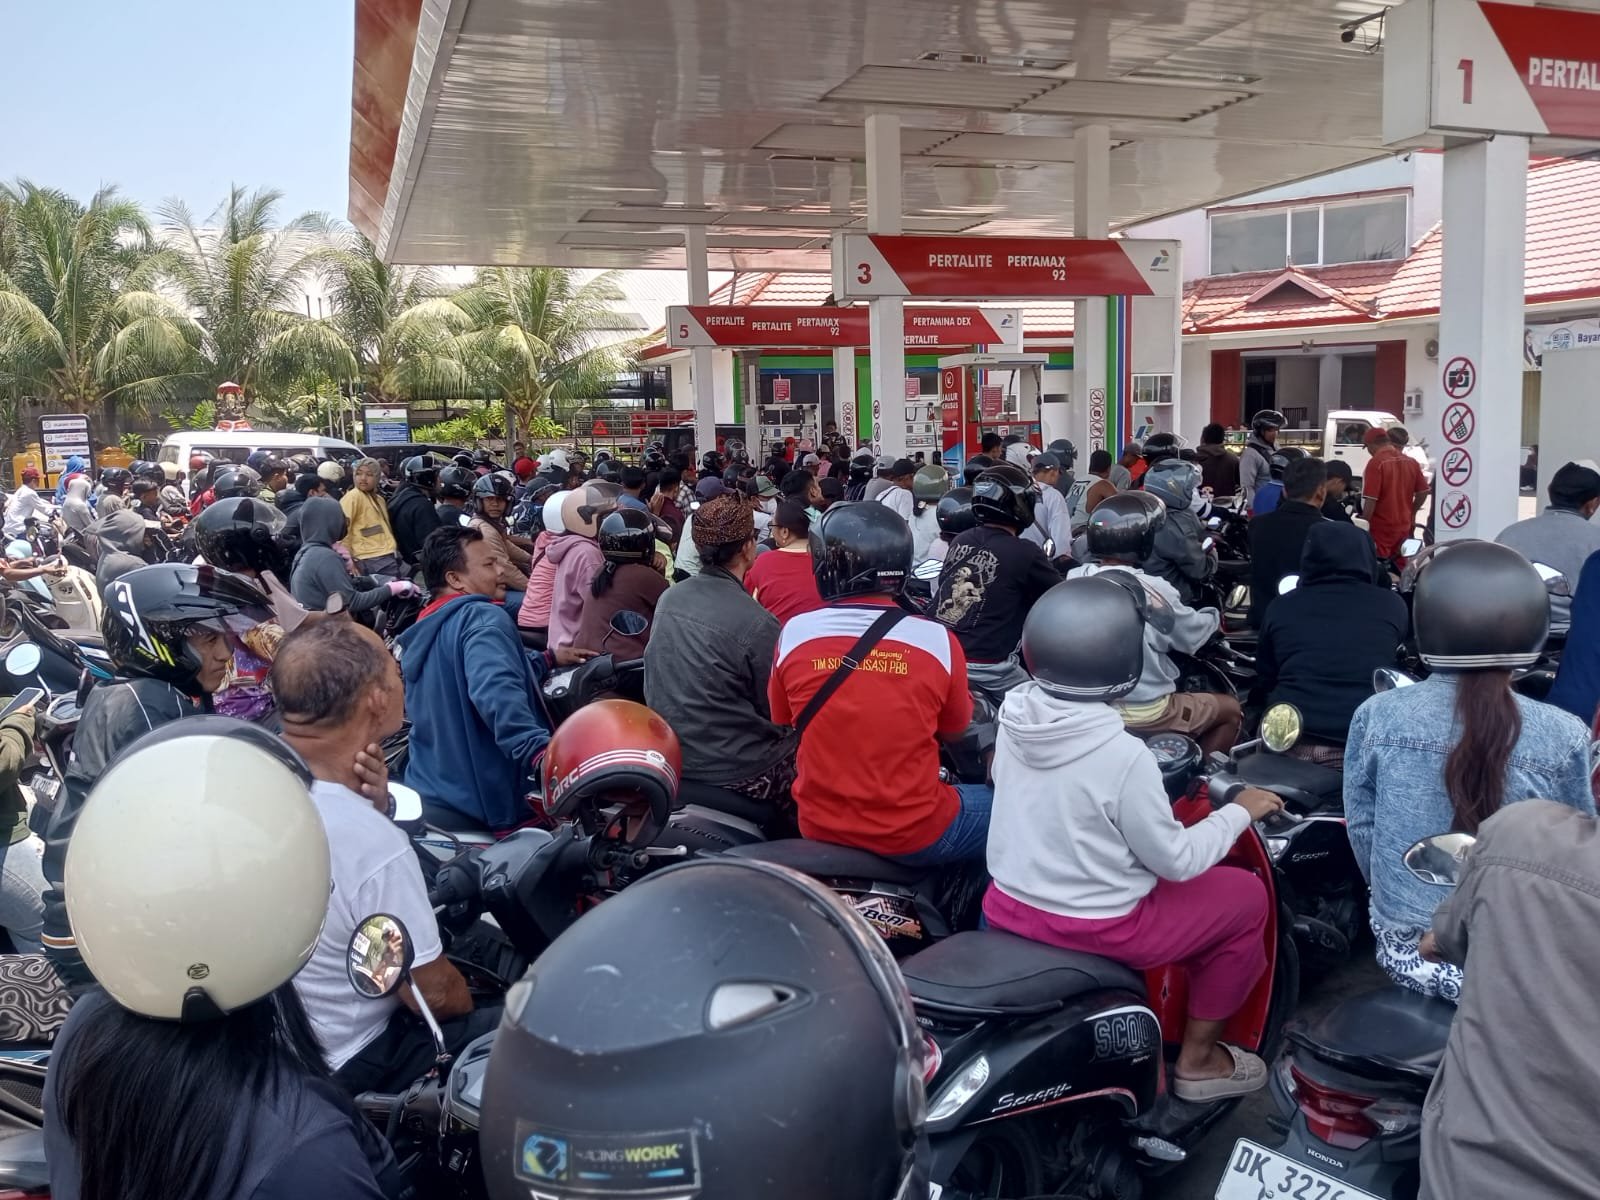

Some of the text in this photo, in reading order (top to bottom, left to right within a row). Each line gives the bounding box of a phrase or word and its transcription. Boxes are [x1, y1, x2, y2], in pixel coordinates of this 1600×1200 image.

[1528, 57, 1600, 91] PERTAL
[1457, 58, 1474, 104] 1
[929, 254, 1066, 267] PERTALITE PERTAMAX
[857, 263, 872, 284] 3
[1052, 269, 1066, 281] 92
[706, 316, 745, 326] PERTALITE
[752, 321, 792, 331] PERTALITE
[797, 318, 839, 327] PERTAMAX
[913, 317, 971, 326] PERTAMINA DEX
[679, 325, 689, 339] 5
[830, 327, 839, 336] 92
[903, 335, 938, 344] ERTALITE
[811, 657, 826, 670] TIM
[889, 661, 908, 675] PBB
[1233, 1146, 1271, 1183] DK
[1307, 1148, 1344, 1168] HONDA
